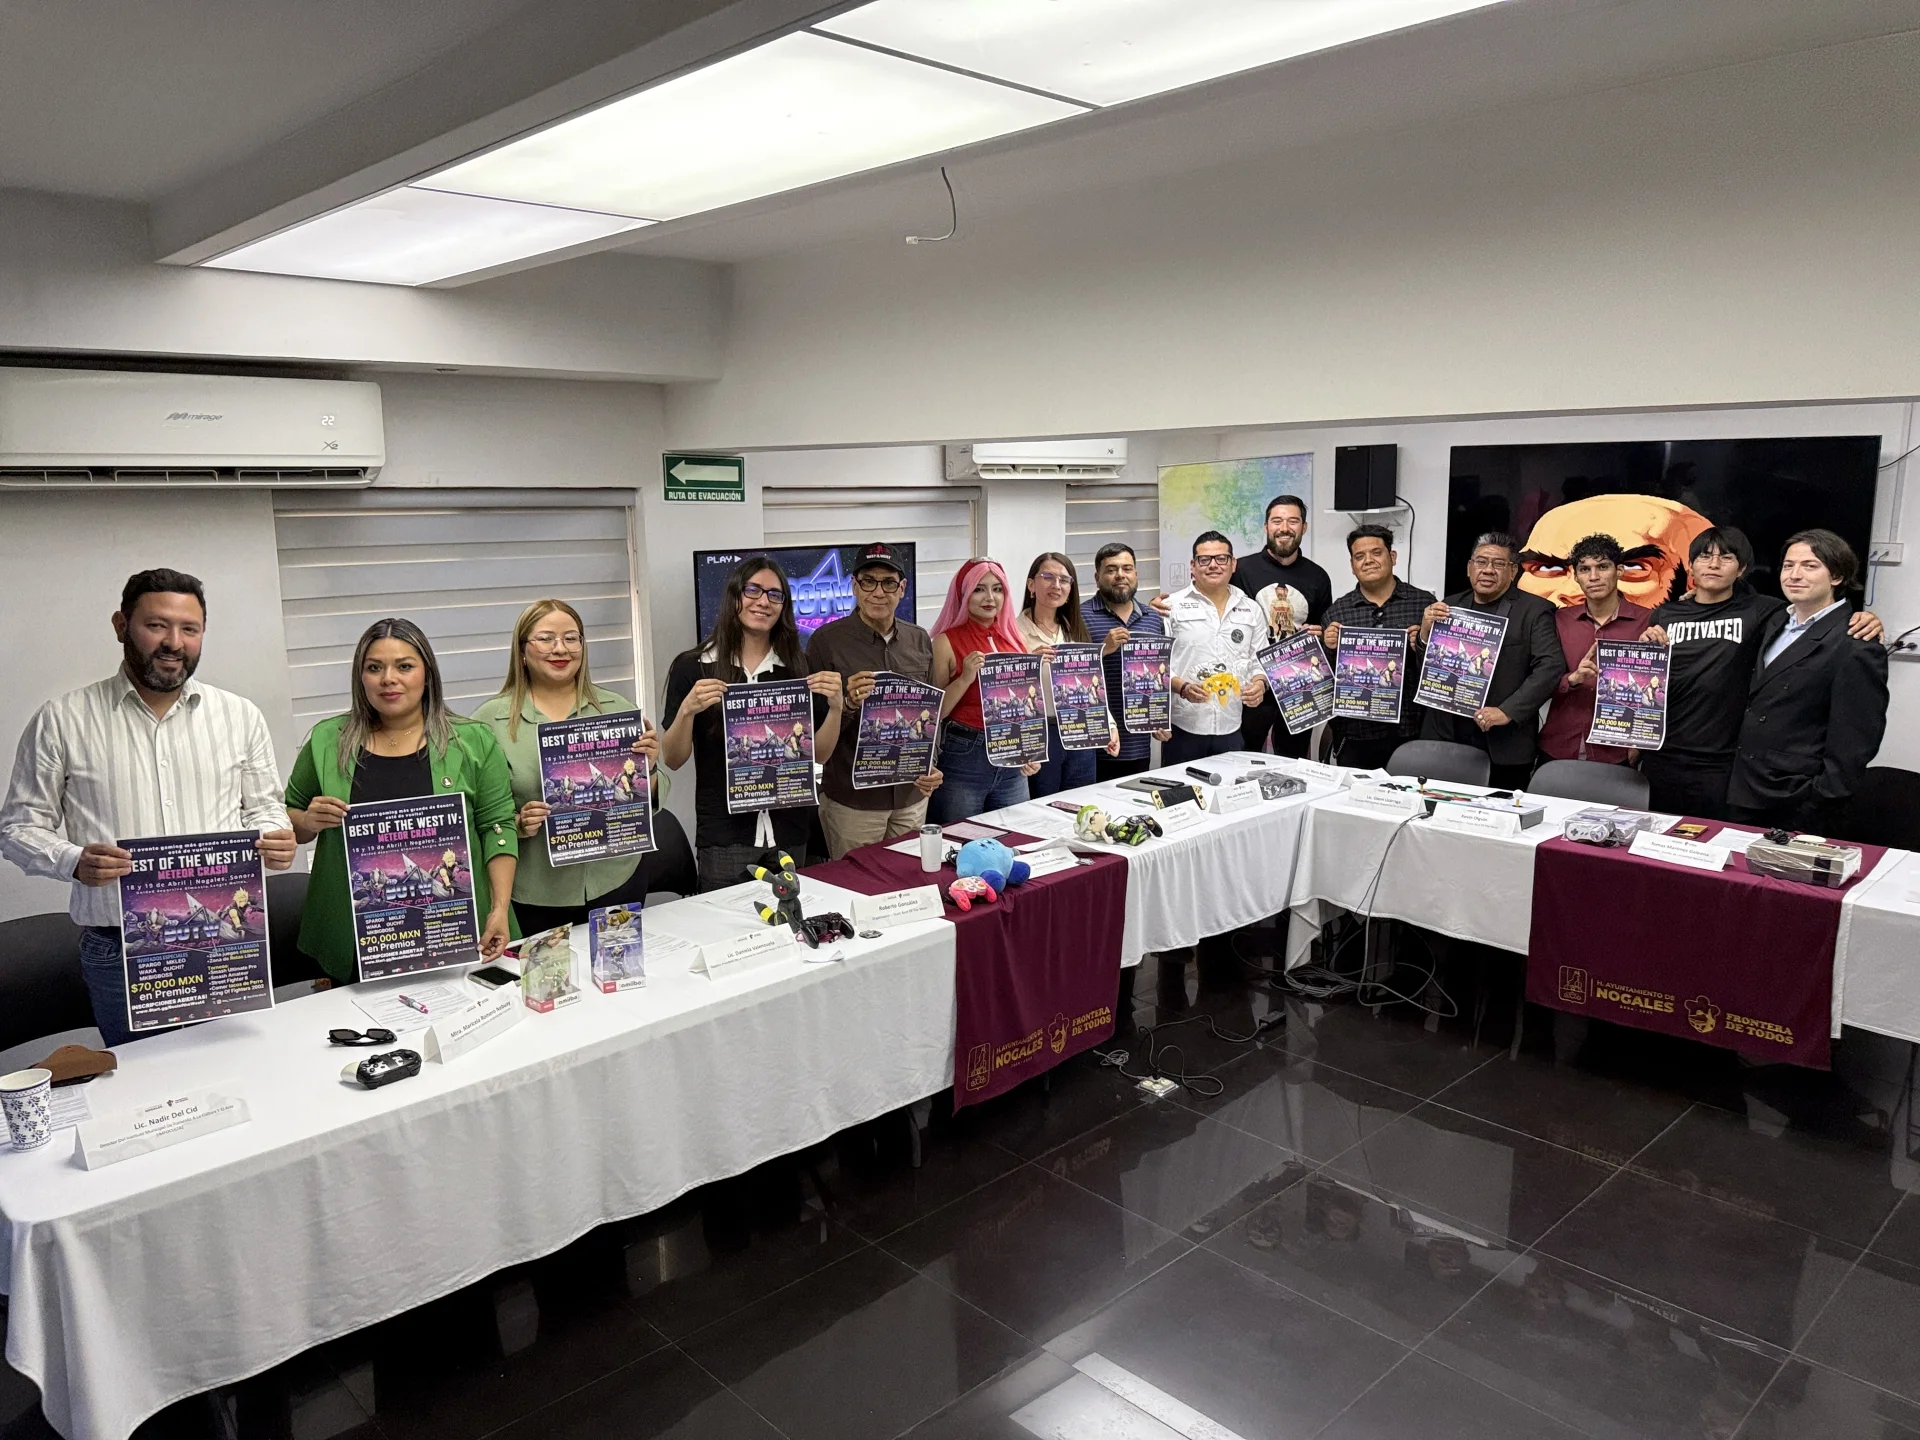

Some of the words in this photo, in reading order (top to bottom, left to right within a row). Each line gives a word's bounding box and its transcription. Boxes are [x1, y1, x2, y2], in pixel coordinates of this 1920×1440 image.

[187, 413, 223, 421] mirage
[321, 415, 335, 425] 22
[698, 491, 741, 500] EVACUACIÓN
[707, 556, 732, 564] PLAY
[1462, 621, 1474, 629] THE
[1475, 624, 1492, 633] WEST
[1667, 617, 1742, 645] MOTIVATED
[1357, 638, 1365, 646] OF
[1378, 639, 1394, 647] WEST
[1260, 653, 1273, 665] BEST
[1293, 640, 1307, 651] WEST
[1600, 649, 1617, 657] BEST
[1628, 650, 1639, 658] THE
[1641, 652, 1657, 660] WEST
[981, 666, 994, 676] BEST
[995, 666, 1002, 674] OF
[1004, 664, 1013, 673] THE
[1015, 663, 1030, 671] WEST
[868, 686, 884, 696] EST
[885, 685, 894, 694] OF
[896, 685, 908, 694] THE
[910, 686, 929, 695] WEST
[726, 699, 745, 710] BEST
[748, 698, 758, 708] OF
[760, 696, 774, 706] THE
[776, 695, 797, 704] WEST
[798, 694, 809, 703] IV:
[747, 706, 770, 715] METEOR
[542, 735, 565, 747] BEST
[568, 733, 578, 744] OF
[582, 731, 599, 742] THE
[600, 728, 626, 740] WEST
[628, 726, 641, 737] IV:
[568, 743, 595, 753] METEOR
[596, 739, 619, 749] CRASH
[730, 784, 757, 793] $70,000
[744, 790, 770, 798] Premios
[349, 823, 374, 837] BEST
[378, 821, 391, 833] OF
[394, 818, 414, 831] THE
[417, 815, 444, 828] WEST
[447, 813, 462, 825] IV:
[378, 831, 408, 842] METEOR
[410, 828, 437, 838] CRASH
[550, 833, 583, 845] $70,000
[584, 830, 603, 838] MXN
[568, 838, 599, 849] Premios
[131, 860, 153, 873] EST
[159, 857, 173, 870] OF
[178, 855, 201, 869] THE
[205, 851, 238, 866] WEST
[242, 850, 258, 861] IV:
[158, 868, 195, 880] METEOR
[197, 865, 228, 876] CRASH
[230, 873, 255, 881] Sonora
[360, 933, 398, 946] $70,000
[399, 930, 420, 940] MXN
[380, 940, 416, 951] Premios
[131, 978, 176, 993] $70,000
[178, 975, 204, 986] MXN
[621, 980, 641, 988] amiibo
[1606, 982, 1663, 999] AYUNTAMIENTO
[139, 993, 153, 1001] en
[155, 985, 197, 999] Premios
[558, 995, 578, 1005] amiibo
[1596, 987, 1674, 1013] NOGALES
[1072, 1006, 1110, 1026] FRONTERA
[1071, 1027, 1082, 1037] DE
[1083, 1014, 1111, 1031] TODOS
[1726, 1013, 1793, 1036] FRONTERA
[1037, 1028, 1043, 1036] DE
[1724, 1022, 1744, 1033] DE
[1747, 1028, 1794, 1045] TODOS
[995, 1037, 1044, 1069] NOGALES
[148, 1115, 170, 1126] Nadir
[171, 1110, 184, 1119] Del
[186, 1106, 198, 1114] Cid
